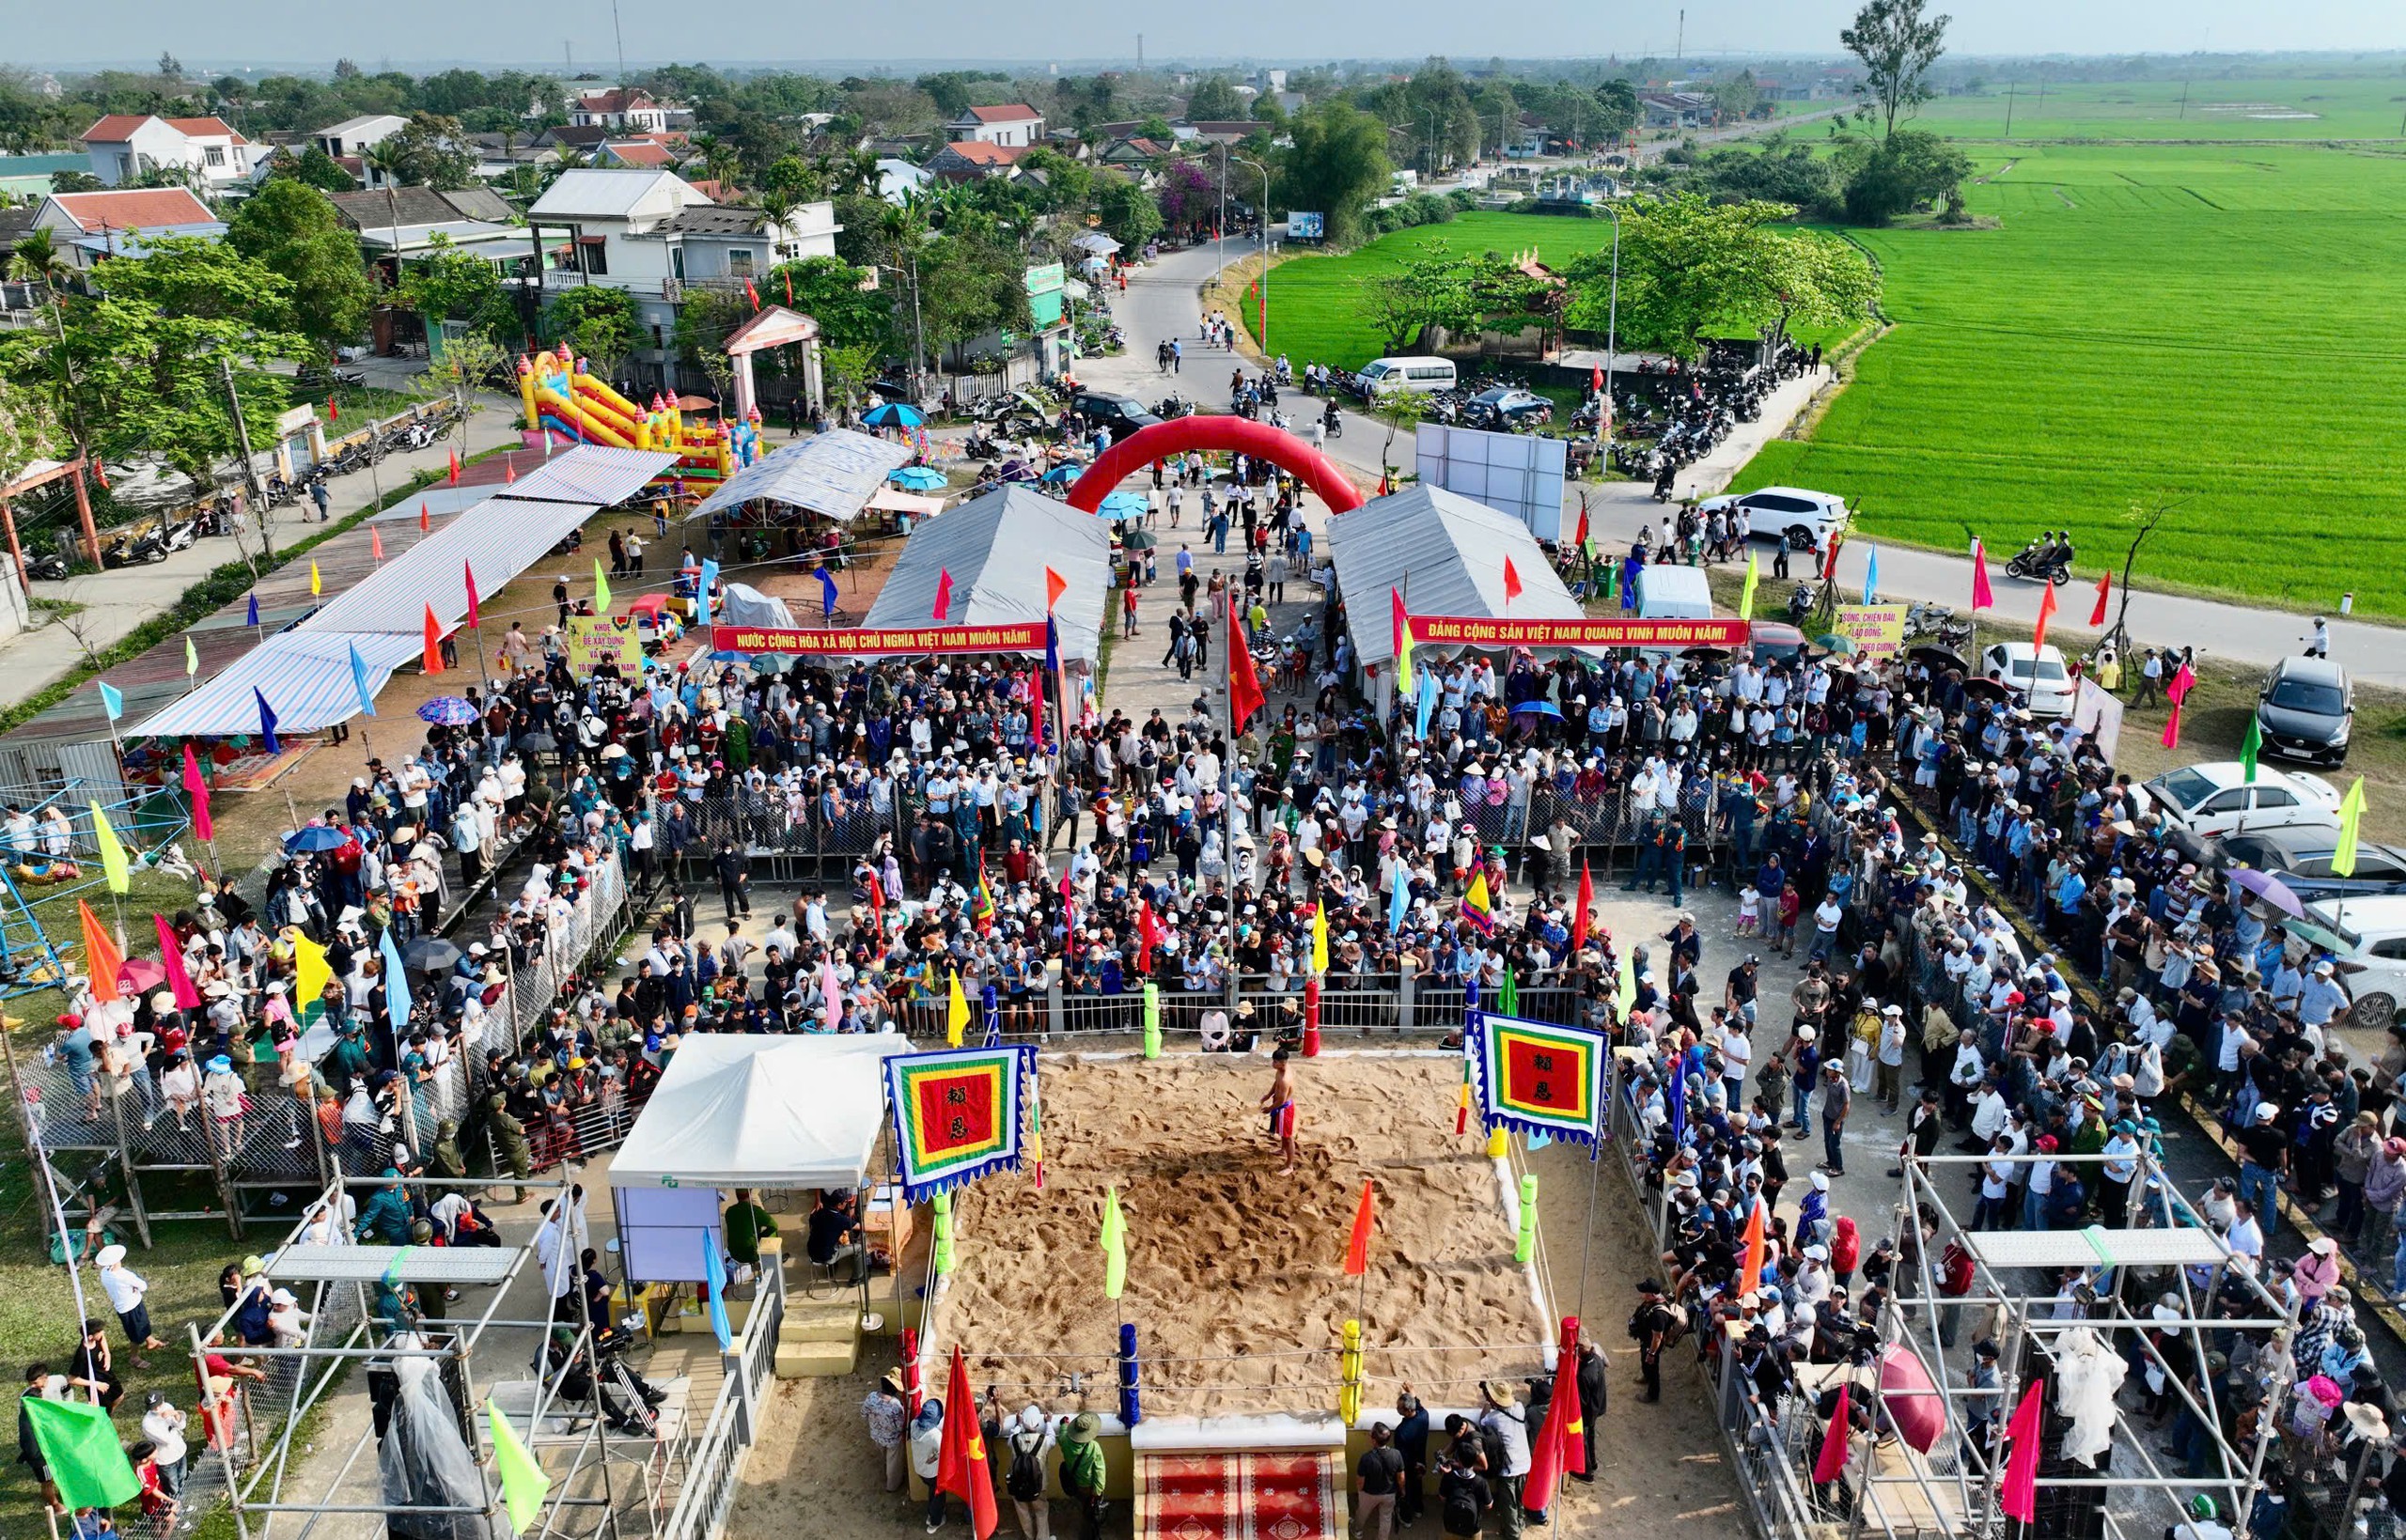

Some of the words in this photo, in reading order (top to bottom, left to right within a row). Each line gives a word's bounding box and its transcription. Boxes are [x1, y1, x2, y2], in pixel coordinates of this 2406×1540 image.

[737, 632, 765, 647] NƯỚC
[768, 633, 797, 650] CỘNG
[799, 633, 820, 648] HÒA
[822, 633, 836, 648] XÃ
[838, 633, 856, 651] HỘI
[860, 631, 881, 648] CHỦ
[883, 632, 915, 647] NGHĨA
[917, 631, 939, 649] VIỆT
[942, 632, 966, 646] NAM
[969, 630, 1000, 645] MUÔN
[1002, 630, 1031, 645] NĂM!
[1429, 620, 1461, 638] ĐẢNG
[1463, 623, 1495, 641] CỘNG
[1499, 623, 1523, 640] SẢN
[1527, 625, 1552, 643] VIỆT
[1554, 626, 1581, 640] NAM
[1584, 626, 1623, 640] QUANG
[1626, 627, 1654, 640] VINH
[1656, 624, 1692, 641] MUÔN
[1695, 625, 1727, 641] NĂM!
